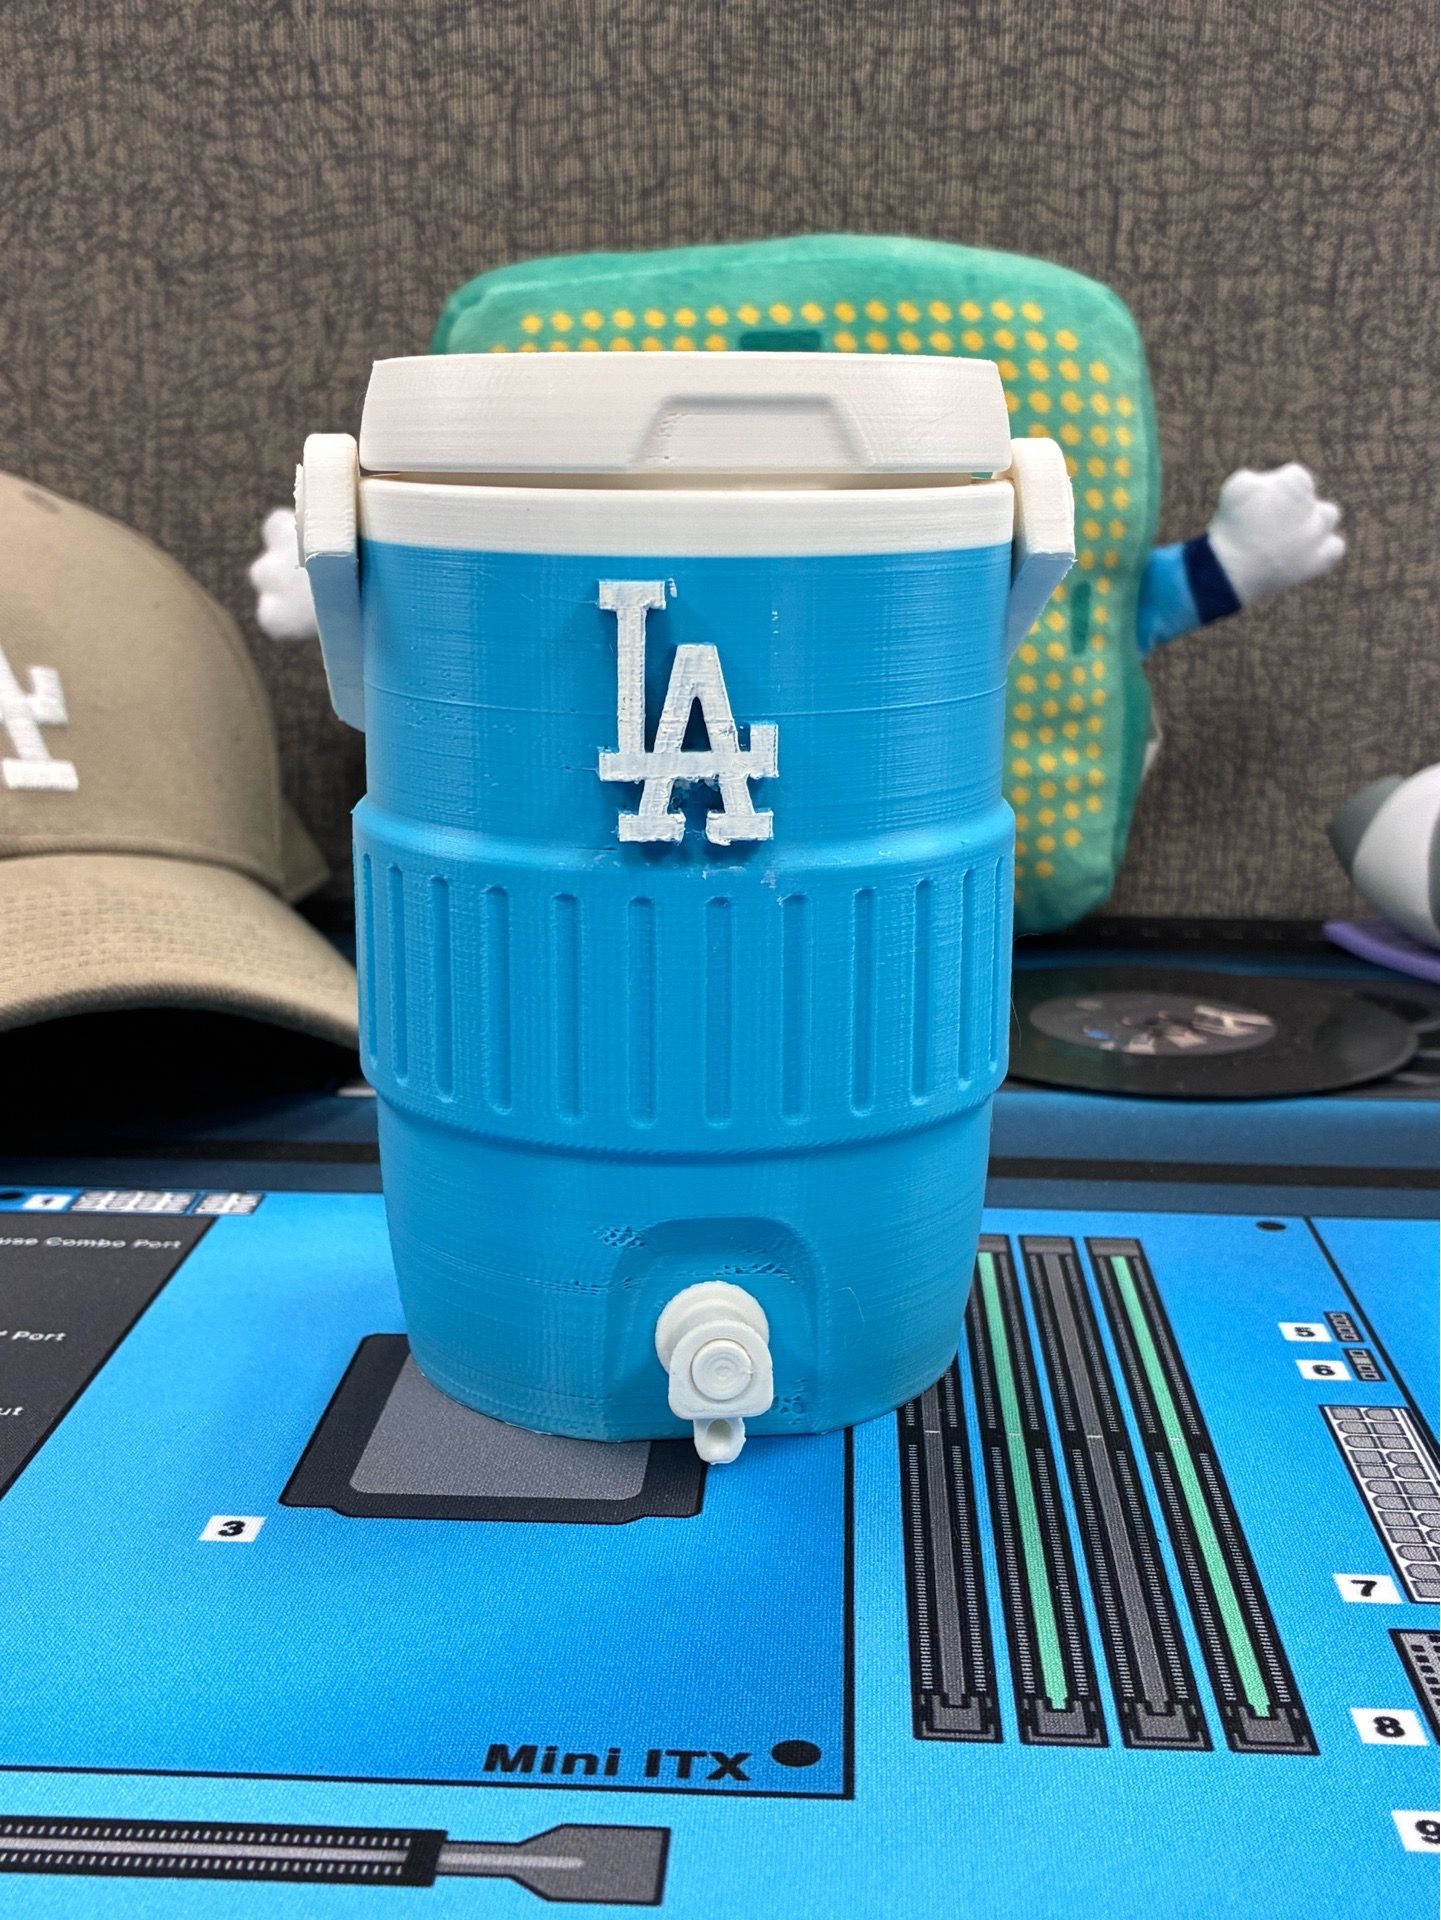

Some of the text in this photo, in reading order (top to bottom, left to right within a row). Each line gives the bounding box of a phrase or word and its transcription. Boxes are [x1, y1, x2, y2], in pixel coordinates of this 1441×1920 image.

[598, 578, 779, 846] LA
[45, 1236, 127, 1249] Combo
[132, 1238, 182, 1249] Port
[11, 1330, 67, 1341] Port
[1294, 1326, 1316, 1338] 5
[1312, 1364, 1336, 1376] 6
[217, 1520, 246, 1537] 3
[1350, 1580, 1377, 1597] 7
[1373, 1716, 1405, 1738] 8
[482, 1743, 752, 1782] Mini ITX
[1414, 1819, 1440, 1845] 9
